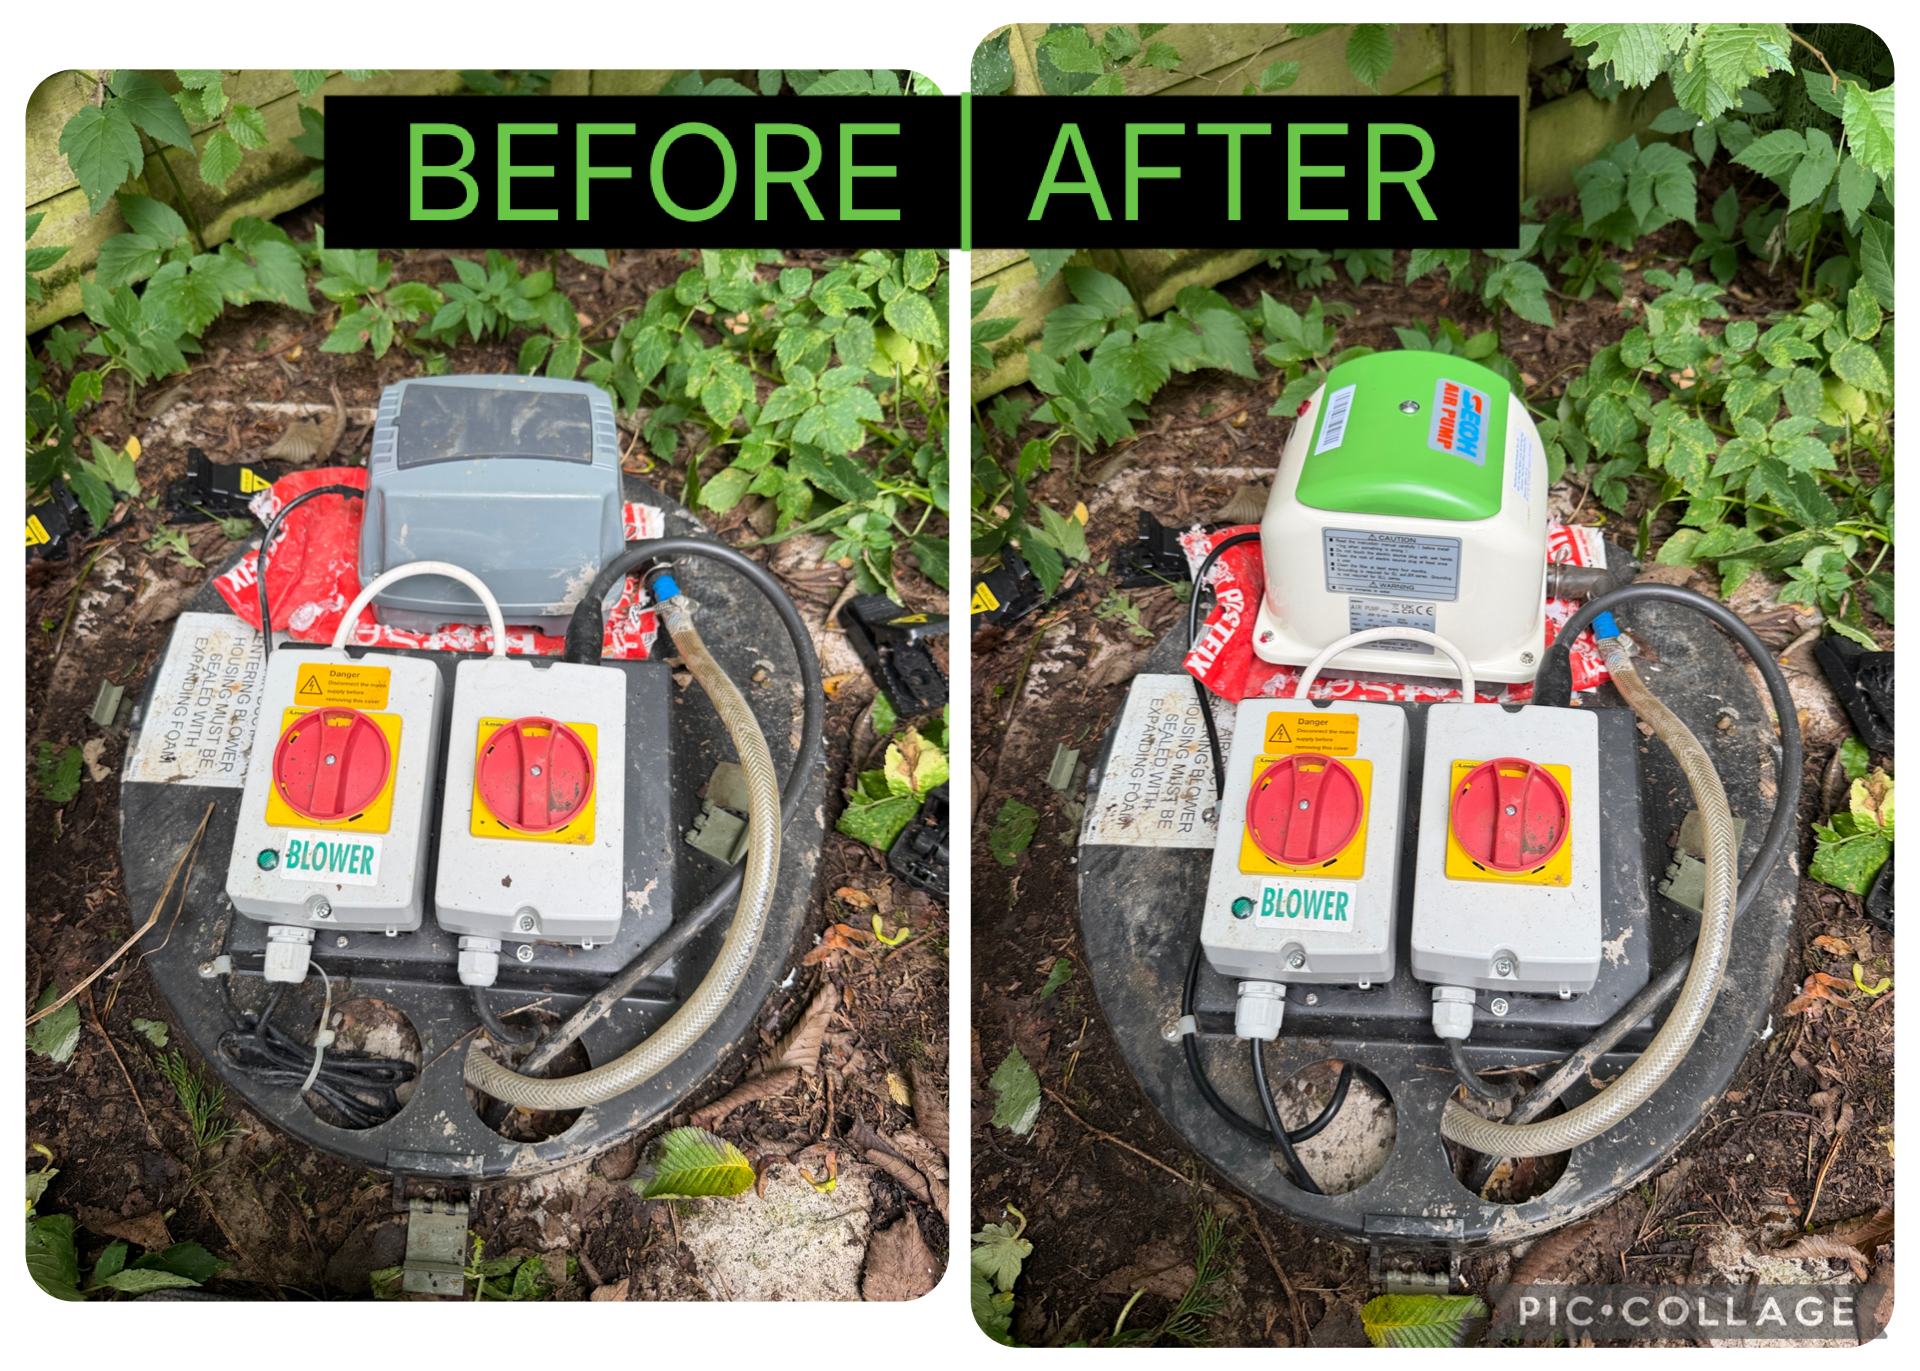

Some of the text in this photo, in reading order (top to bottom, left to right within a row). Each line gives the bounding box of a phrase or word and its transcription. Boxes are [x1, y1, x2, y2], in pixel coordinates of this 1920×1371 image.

[1437, 382, 1460, 450] AIR PUMP
[1456, 389, 1482, 458] SECOH
[1378, 535, 1416, 543] CAUTION
[159, 637, 208, 764] EXPANDING FOAM
[184, 653, 223, 748] SEALED WITH
[198, 637, 246, 769] HOUSING MUST BE
[238, 636, 264, 705] ENTERING
[330, 670, 360, 679] Danger
[218, 710, 247, 772] BLOWER
[1298, 718, 1328, 726] Danger
[1116, 698, 1164, 826] EXPANDING FOAM
[1142, 714, 1180, 810] SEALED WITH
[1157, 697, 1200, 830] HOUSING MUST BE
[1178, 768, 1204, 832] BLOWER
[286, 840, 374, 876] BLOWER
[1260, 887, 1349, 922] BLOWER
